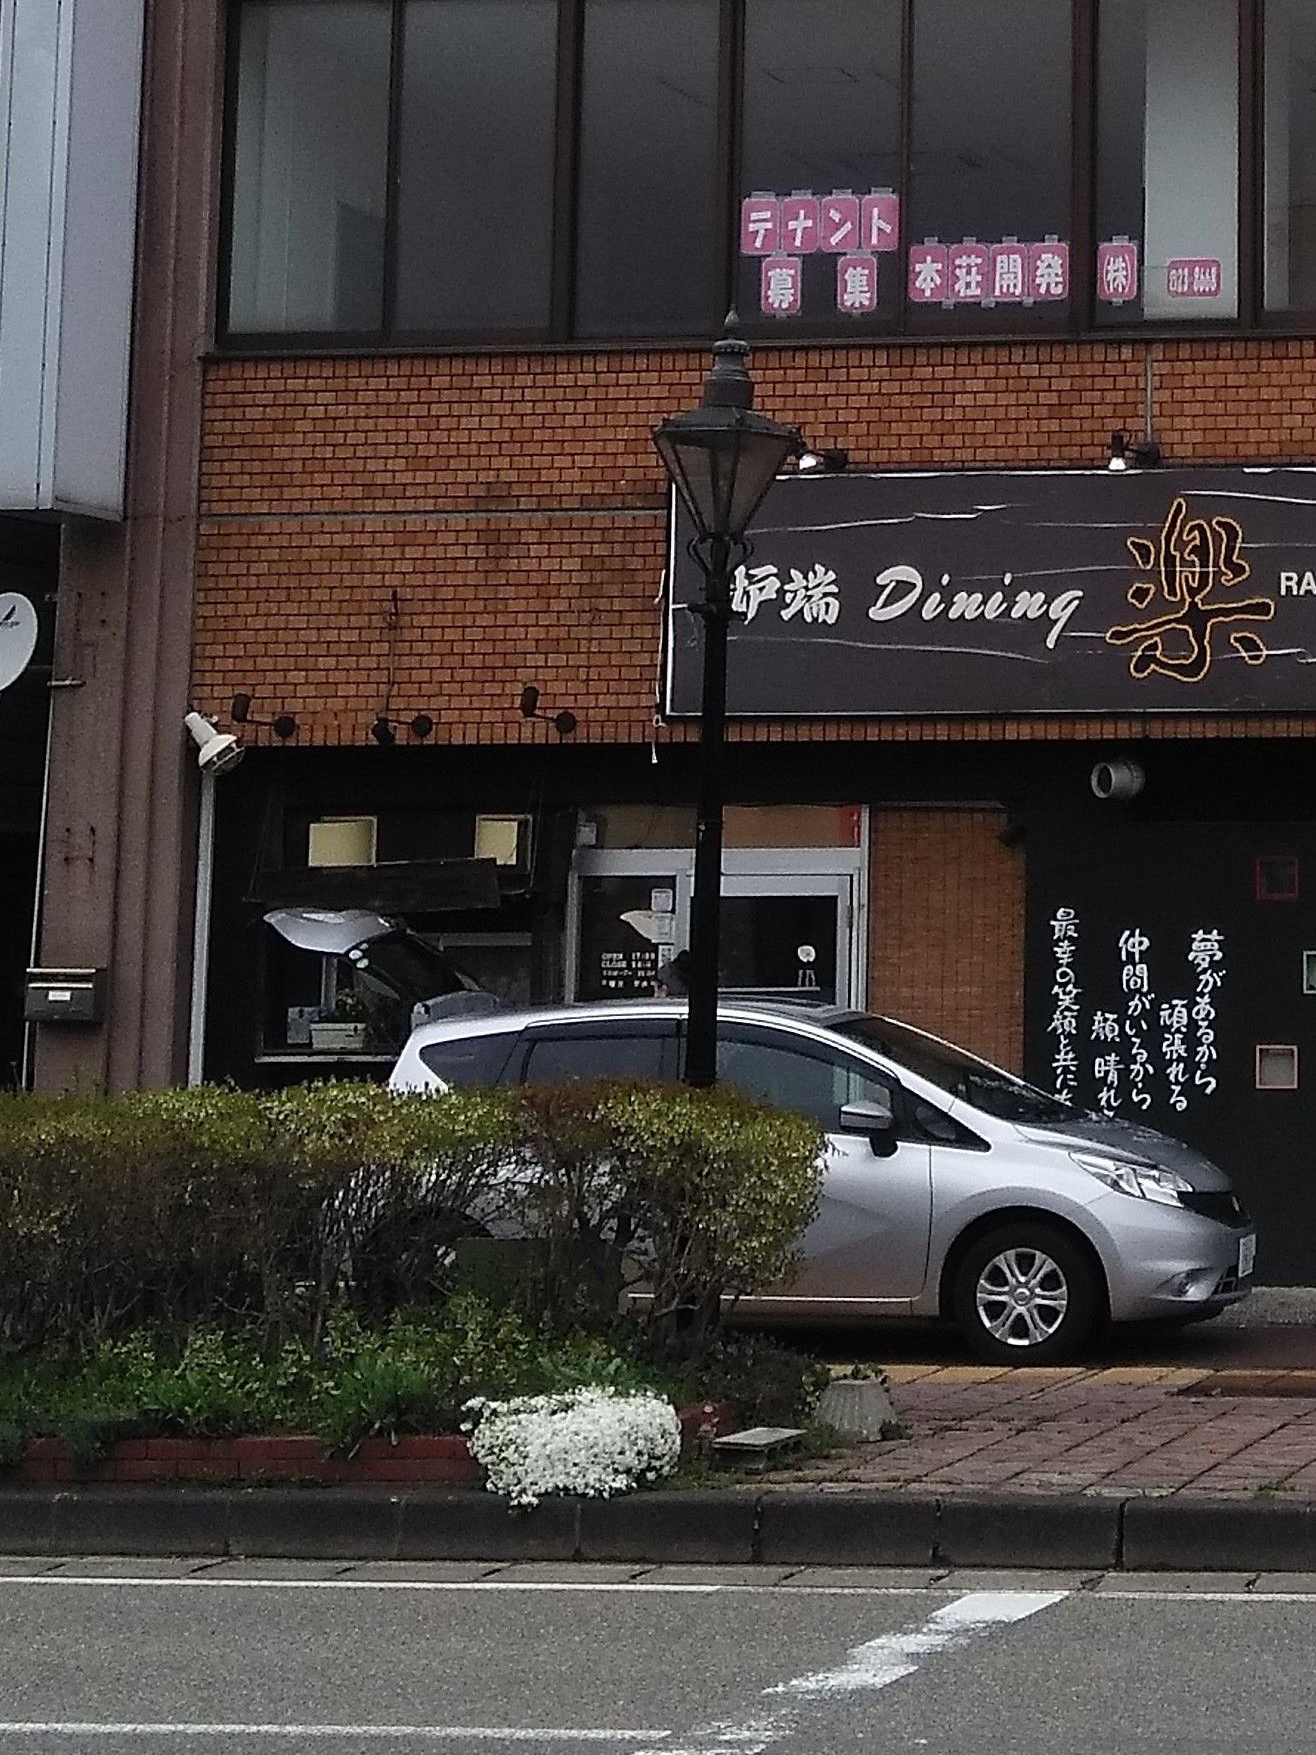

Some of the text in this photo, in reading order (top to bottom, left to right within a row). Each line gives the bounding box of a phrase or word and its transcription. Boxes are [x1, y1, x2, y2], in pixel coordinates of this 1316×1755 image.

[748, 206, 893, 247] テナント
[868, 564, 1084, 649] Dining
[1118, 927, 1156, 1111] 仲間がいるから
[1159, 998, 1190, 1112] 頑張れる
[1187, 928, 1227, 1096] 夢があるから
